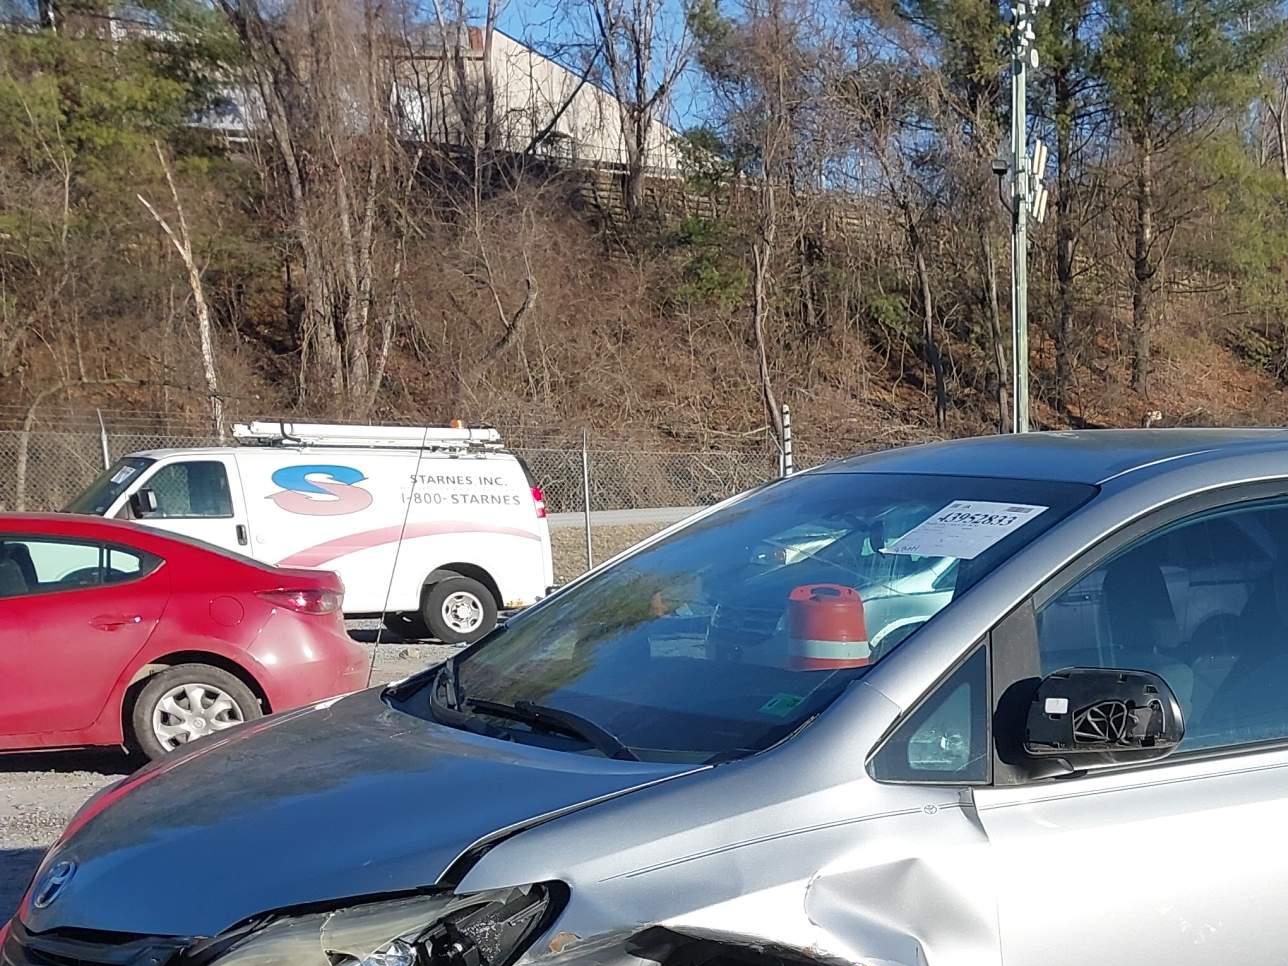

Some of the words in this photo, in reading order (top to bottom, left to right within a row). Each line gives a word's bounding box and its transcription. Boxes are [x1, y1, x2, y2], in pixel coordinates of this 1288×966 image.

[410, 475, 473, 485] STARNES
[479, 476, 508, 487] INC.
[401, 492, 521, 505] 1-800-STARNES
[939, 512, 1018, 526] 43952833
